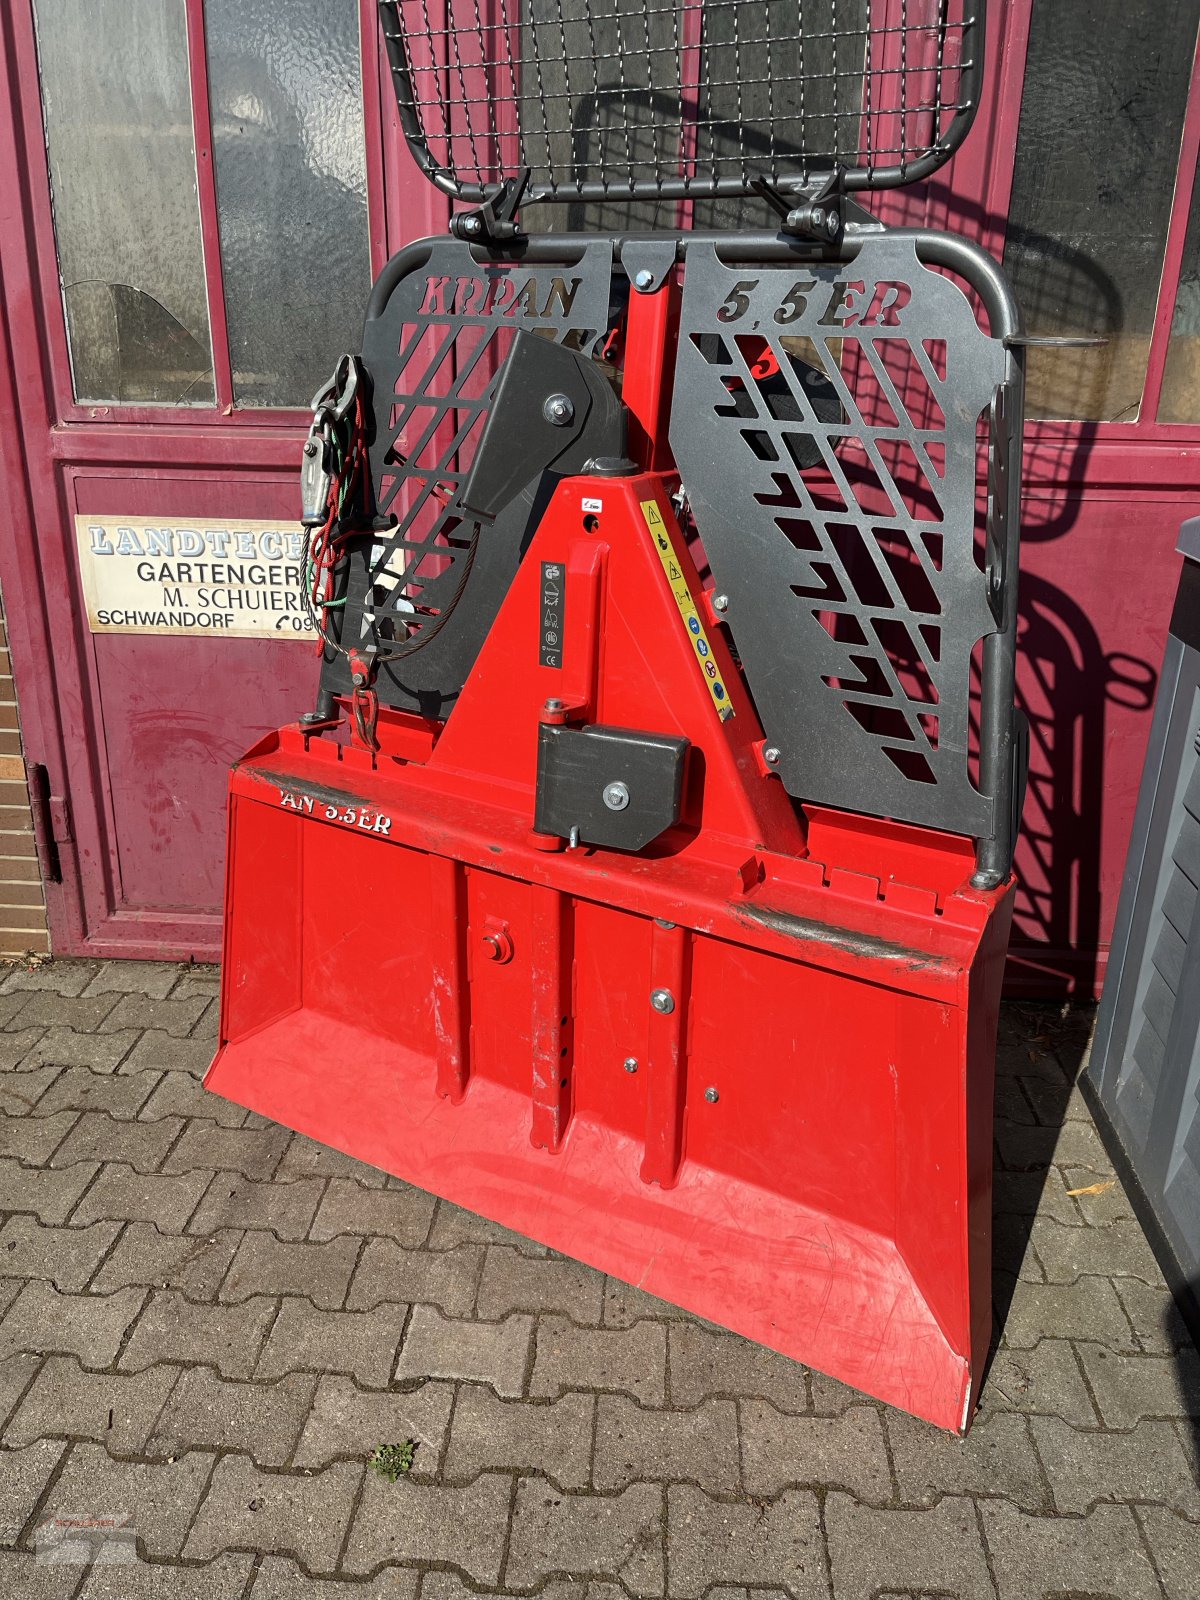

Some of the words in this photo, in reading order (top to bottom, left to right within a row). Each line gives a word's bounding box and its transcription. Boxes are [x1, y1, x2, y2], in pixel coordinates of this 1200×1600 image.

[417, 276, 583, 317] KRPAN
[88, 526, 306, 560] LANDTECH
[163, 587, 189, 608] M.
[97, 609, 235, 628] SCHWANDORF
